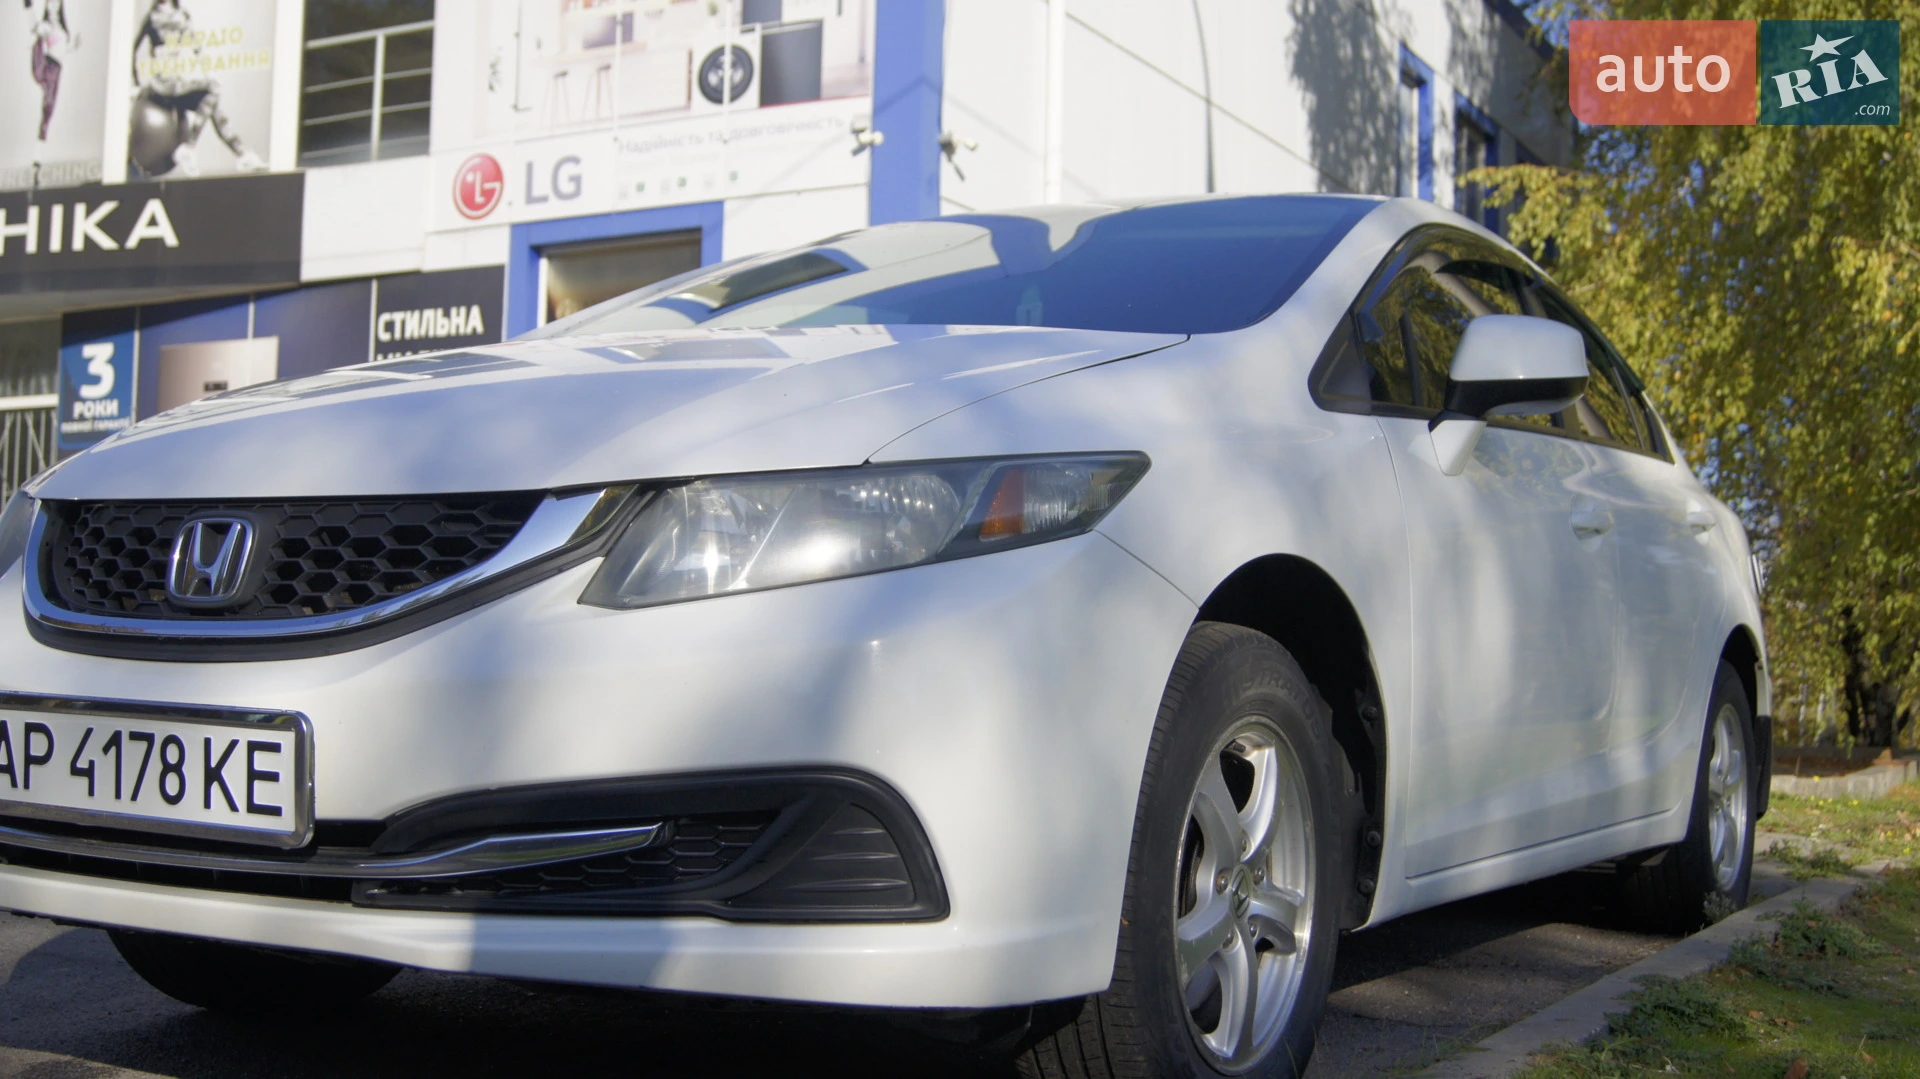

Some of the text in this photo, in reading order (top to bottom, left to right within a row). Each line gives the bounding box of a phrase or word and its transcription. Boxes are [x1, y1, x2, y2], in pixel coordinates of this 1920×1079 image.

[525, 154, 583, 205] LG
[377, 304, 485, 342] СТИЛЬНА
[79, 341, 115, 399] 3
[72, 398, 119, 419] РОКИ
[70, 726, 187, 806] 4178
[203, 736, 283, 817] KE
